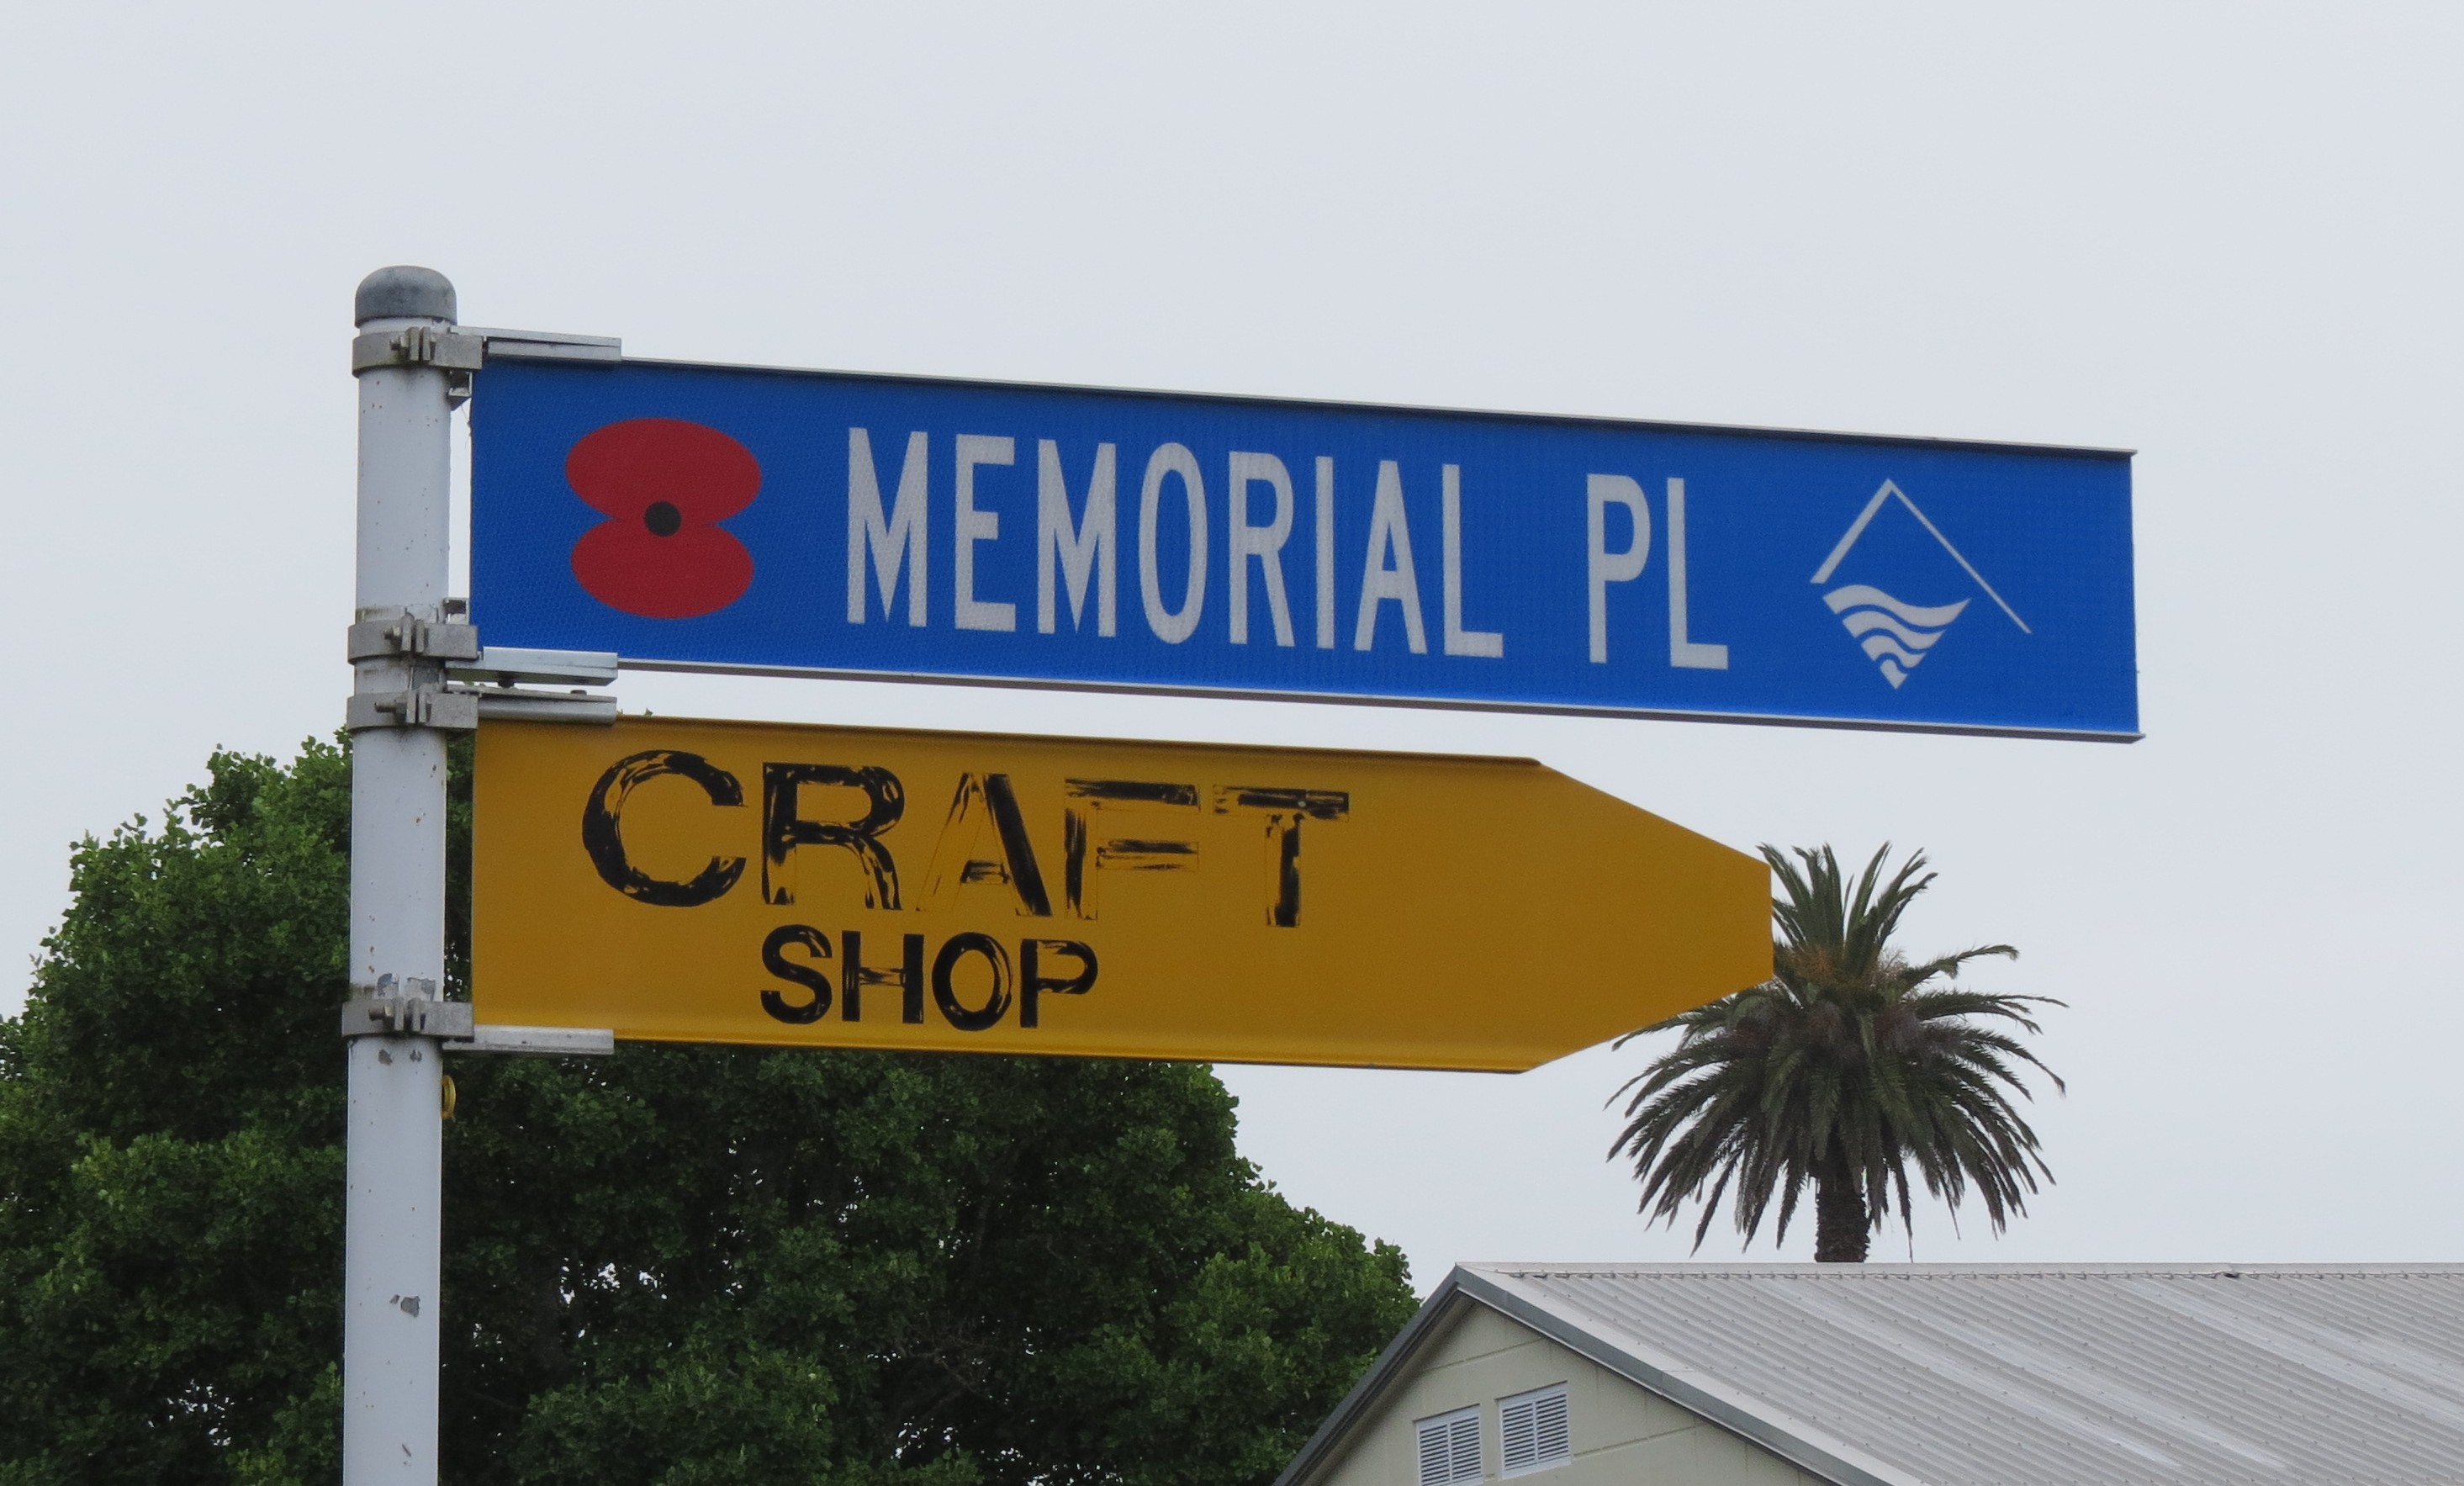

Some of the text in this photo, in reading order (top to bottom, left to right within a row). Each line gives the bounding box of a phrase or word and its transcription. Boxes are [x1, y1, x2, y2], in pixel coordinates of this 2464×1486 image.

[847, 427, 1729, 671] MEMORIAL PL
[582, 748, 1351, 930] CRAFT
[759, 923, 1100, 1034] SHOP
